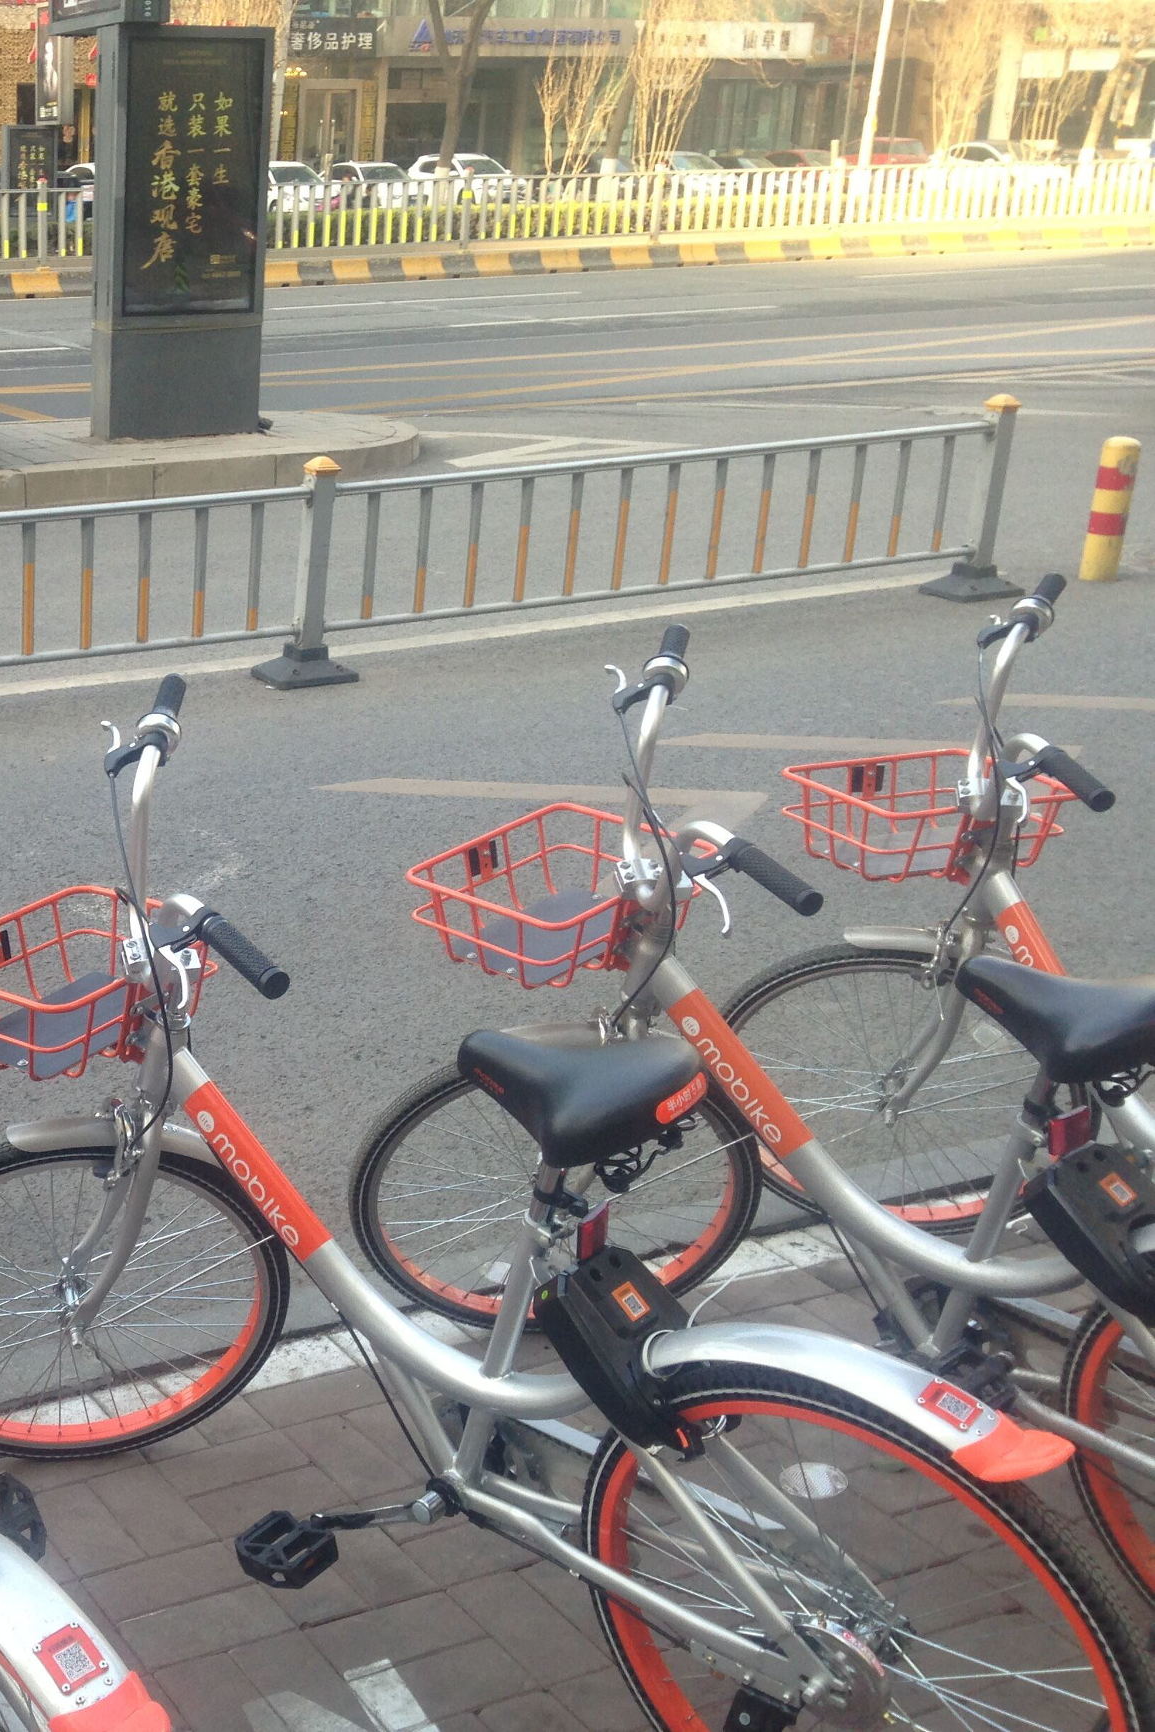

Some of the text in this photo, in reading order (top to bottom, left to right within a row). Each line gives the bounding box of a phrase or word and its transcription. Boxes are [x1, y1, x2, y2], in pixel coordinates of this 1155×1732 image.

[291, 32, 374, 50] 奢侈品护理
[184, 92, 207, 234] 只装一套豪宅
[213, 92, 234, 185] 如果一生
[696, 1038, 781, 1143] mobike
[212, 1133, 299, 1246] mobike
